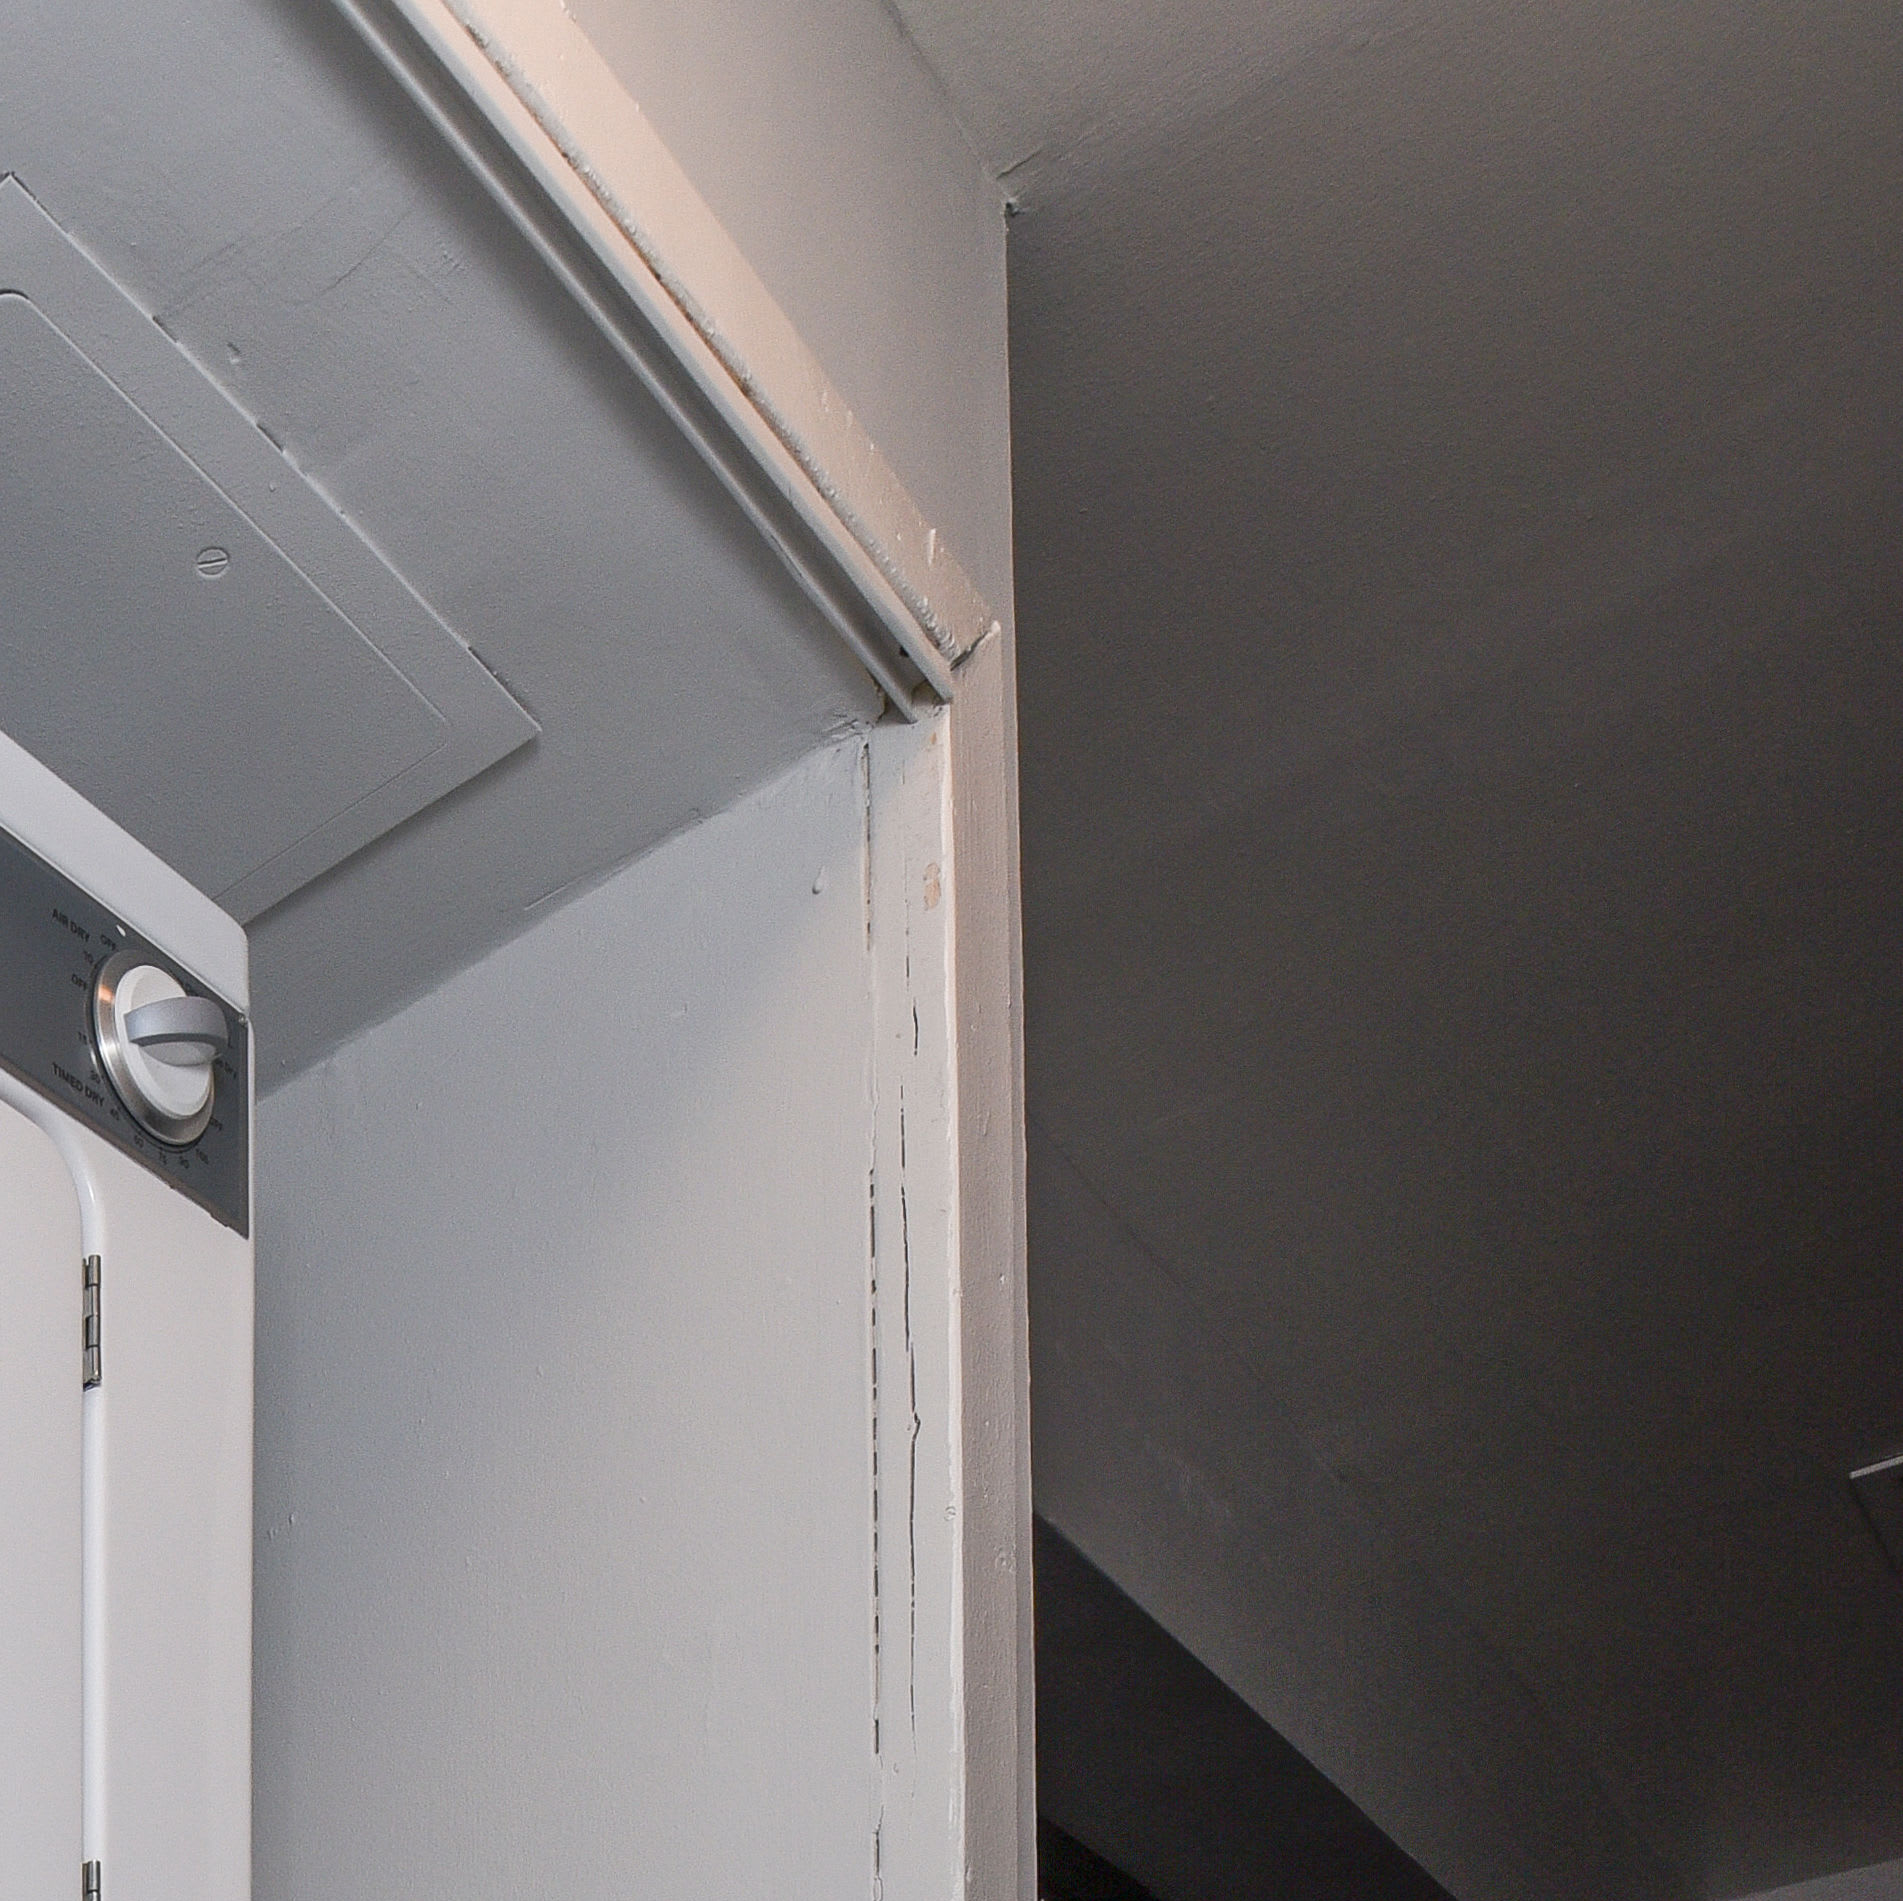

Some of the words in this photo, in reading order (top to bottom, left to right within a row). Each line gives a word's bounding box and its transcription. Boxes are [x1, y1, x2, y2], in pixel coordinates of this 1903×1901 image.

[52, 908, 69, 929] AIR
[70, 921, 90, 943] DRY
[52, 1062, 83, 1093] TIMED
[84, 1086, 105, 1108] DRY
